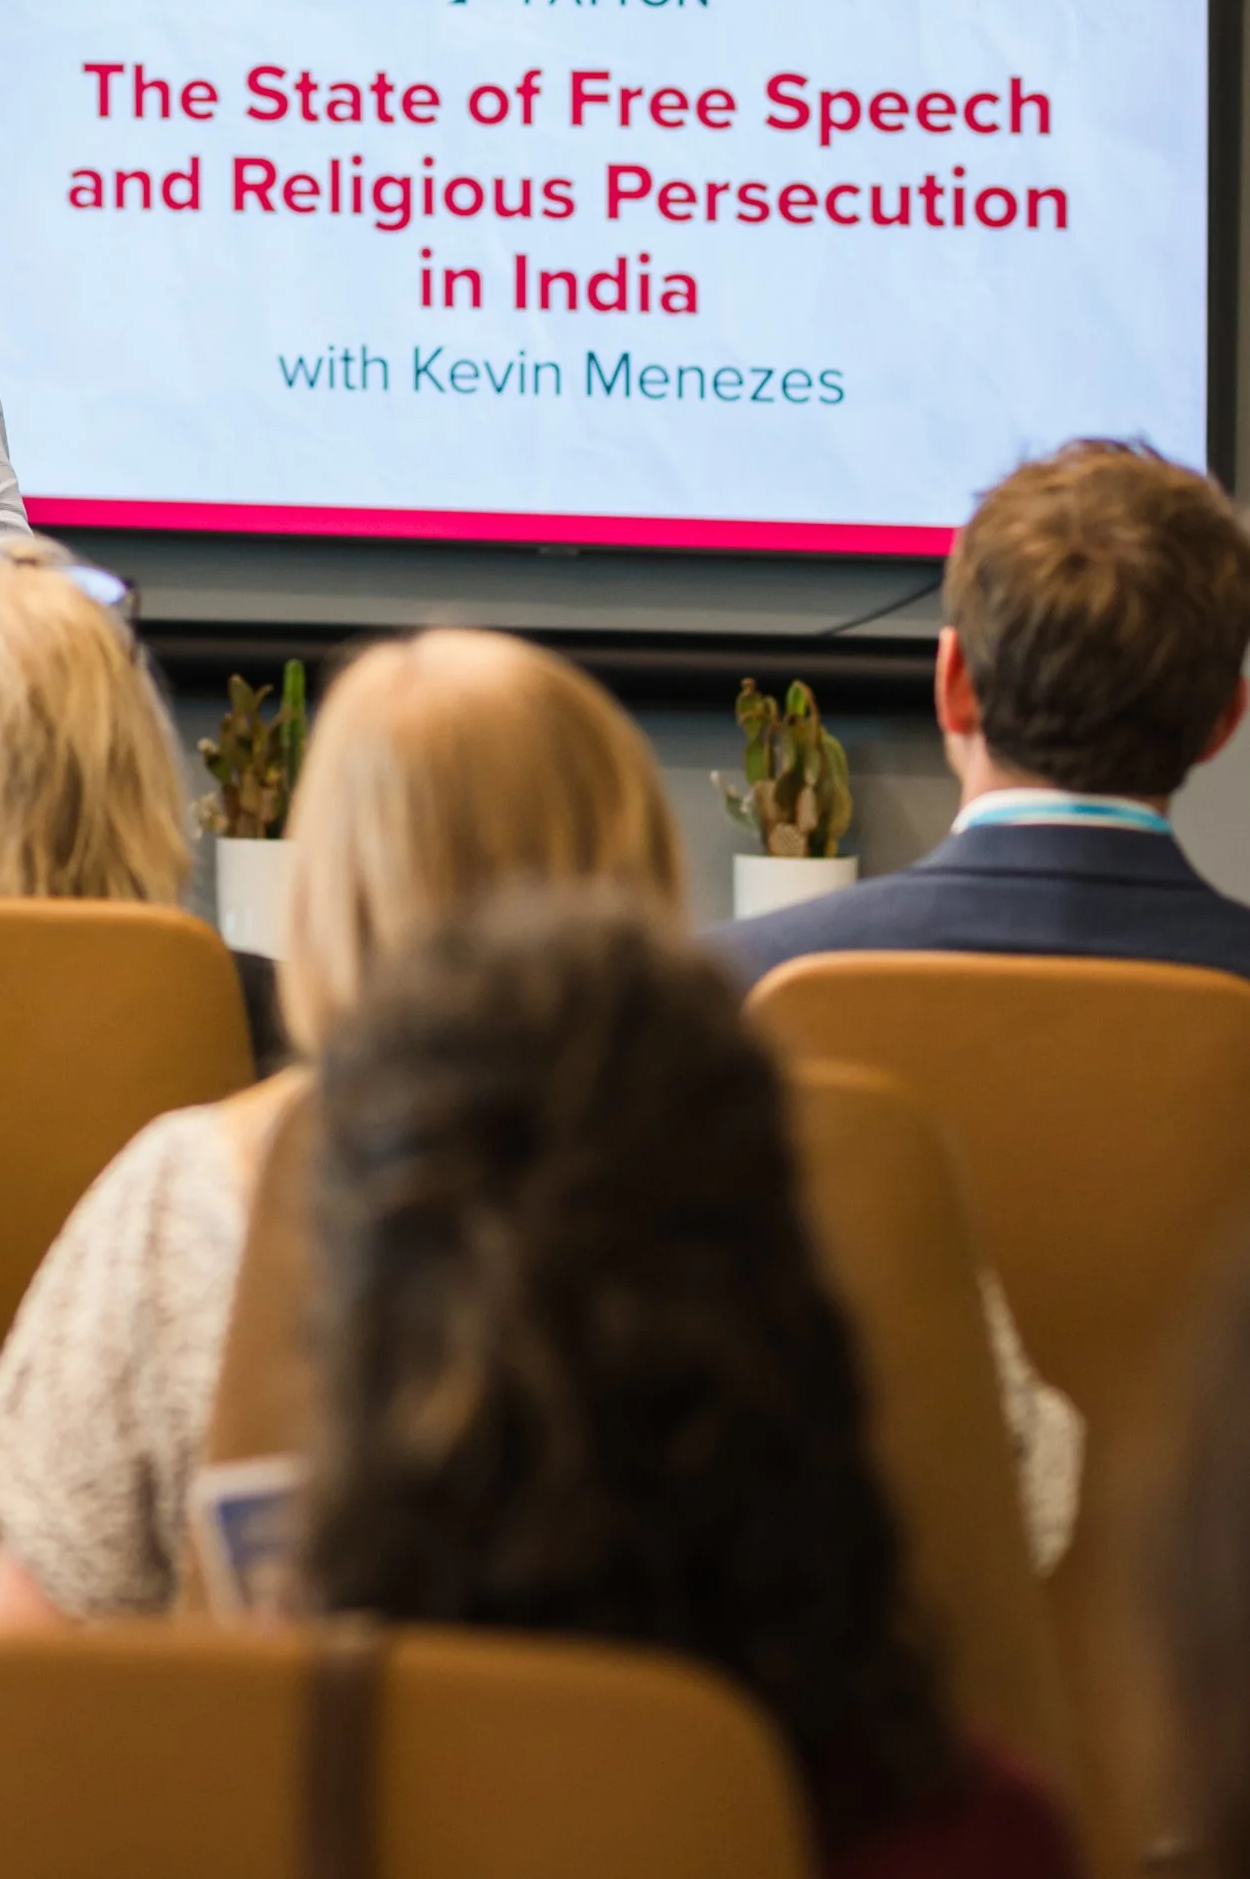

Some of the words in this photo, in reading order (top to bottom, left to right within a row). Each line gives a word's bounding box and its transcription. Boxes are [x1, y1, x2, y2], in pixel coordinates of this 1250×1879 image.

[81, 61, 220, 122] The
[245, 64, 442, 127] State
[466, 68, 543, 128] of
[570, 69, 738, 131] Free
[764, 71, 1052, 149] Speech
[67, 154, 201, 212] and
[232, 154, 576, 233] Religious
[606, 163, 1069, 231] Persecution
[420, 246, 483, 310] in
[514, 251, 699, 316] India
[278, 344, 389, 392] with
[413, 345, 562, 396] Kevin
[585, 349, 846, 405] Menezes
